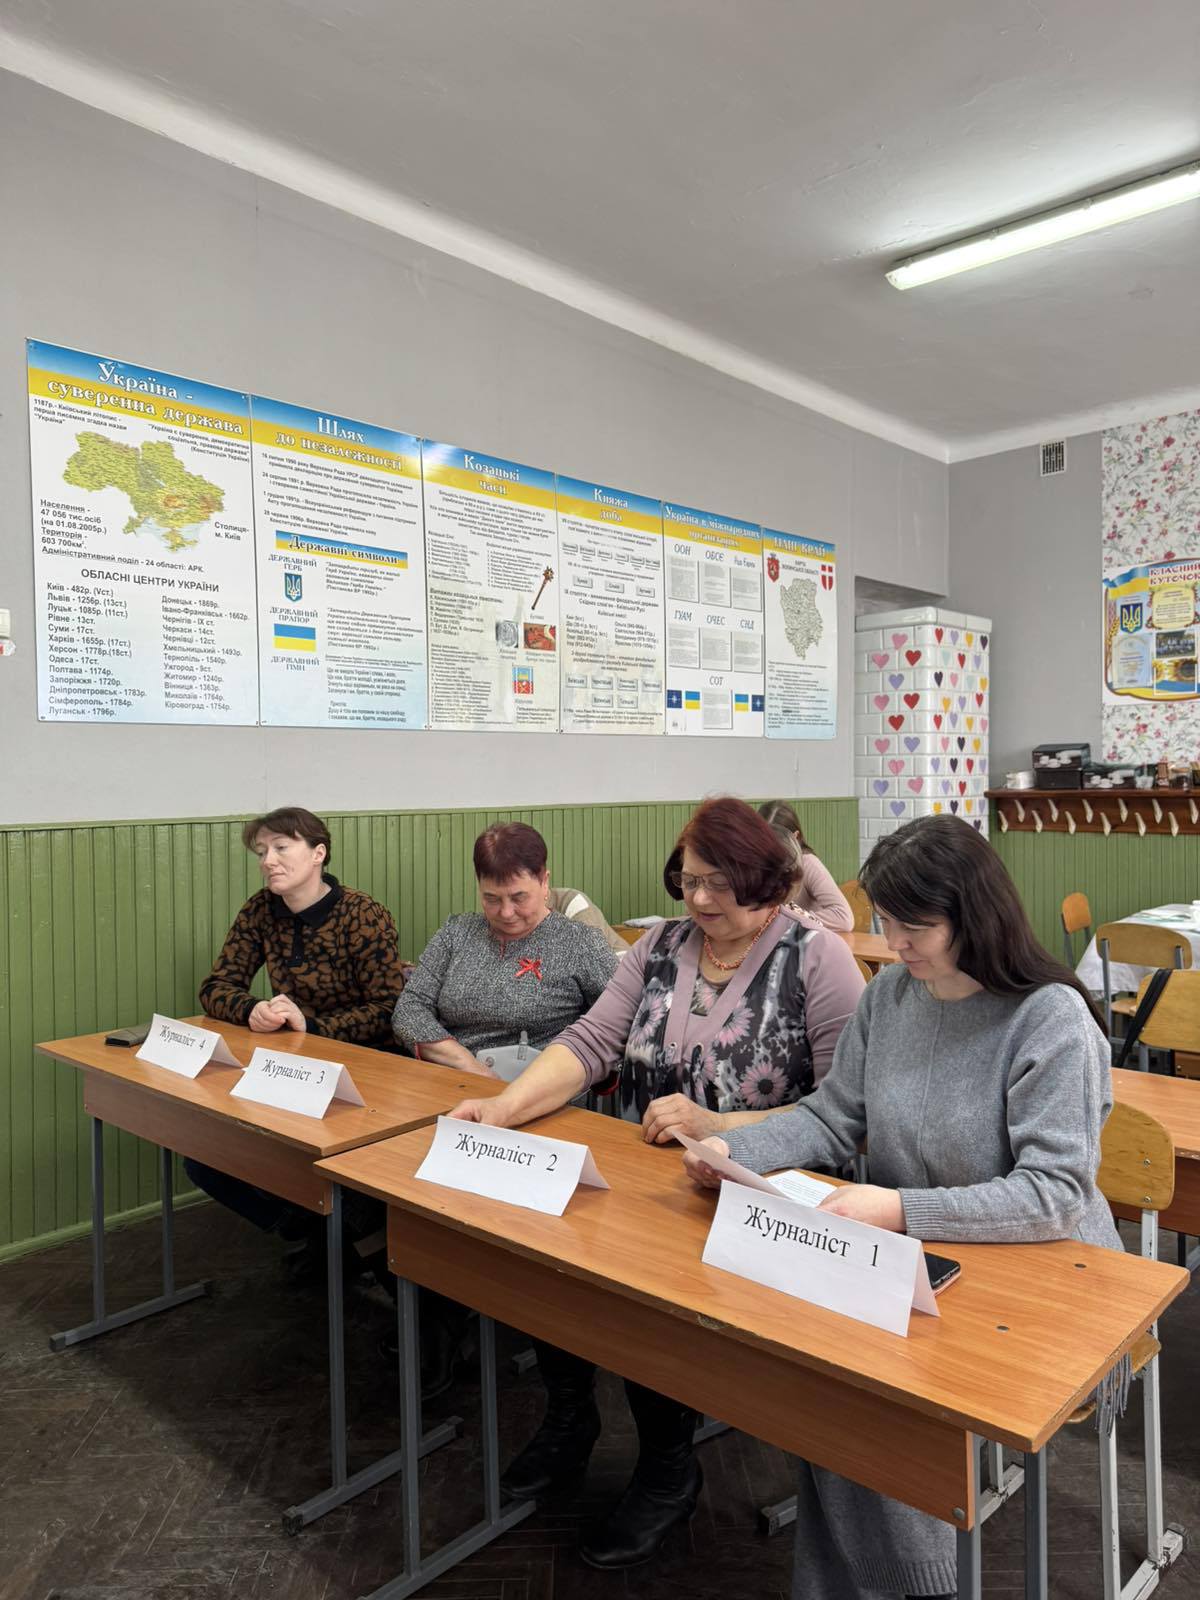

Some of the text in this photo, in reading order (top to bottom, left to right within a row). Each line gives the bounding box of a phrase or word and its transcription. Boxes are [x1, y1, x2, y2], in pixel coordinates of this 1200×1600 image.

[98, 362, 177, 398] Україна
[48, 379, 242, 435] суверенна держава
[317, 416, 364, 443] Шлях
[274, 431, 402, 472] до незалежності
[464, 454, 519, 481] Козацькі
[478, 479, 506, 494] часи
[593, 488, 627, 508] Княжа
[40, 499, 84, 512] Населення
[52, 509, 66, 518] 056
[69, 513, 101, 524] тис.осіб
[665, 505, 698, 523] Україна
[709, 518, 759, 538] міжнародних
[41, 526, 82, 538] Територія
[55, 519, 107, 534] 01.08.2005р.)
[41, 536, 55, 544] 603
[224, 531, 240, 540] Київ
[41, 545, 115, 561] Адміністративний
[117, 556, 139, 564] поділ
[289, 534, 397, 563] Державні символи
[673, 543, 690, 555] ООН
[268, 552, 317, 567] ДЕРЖАВНИЙ
[705, 549, 724, 562] ОБСЄ
[284, 563, 302, 571] ГЕРБ
[81, 568, 219, 592] ОБЛАСНІ ЦЕНТРИ УКРАЇНИ
[47, 581, 64, 591] Київ
[71, 584, 91, 594] 482р.
[47, 592, 127, 609] Львів 1256р. (13ст.)
[161, 595, 191, 605] Донецьк
[47, 602, 128, 619] Луцьк 1085р. (11ст.)
[269, 604, 317, 618] ДЕРЖАВНИЙ
[47, 613, 95, 624] Рівне 13ст.
[278, 614, 309, 624] ПРАПОР
[48, 623, 95, 634] Суми 17ст.
[48, 633, 130, 648] Харків 1655р. (17ст.)
[48, 643, 77, 653] Херсон
[48, 654, 99, 664] Одеса 17ст.
[270, 654, 319, 666] ДЕРЖАВНИЙ
[49, 664, 113, 676] Полтава 1174р.
[286, 663, 305, 671] ГІМН
[49, 674, 91, 684] Запоріжжя
[709, 675, 723, 686] СОТ
[49, 685, 117, 696] Дніпропетровськ
[49, 696, 132, 707] Сімферополь 1784р.
[49, 706, 85, 715] Луганськ
[159, 1025, 206, 1050] Журналіст 4
[262, 1059, 326, 1085] Журналіст 3
[455, 1133, 558, 1172] Журналіст 2
[744, 1205, 879, 1269] Журналіст 1
